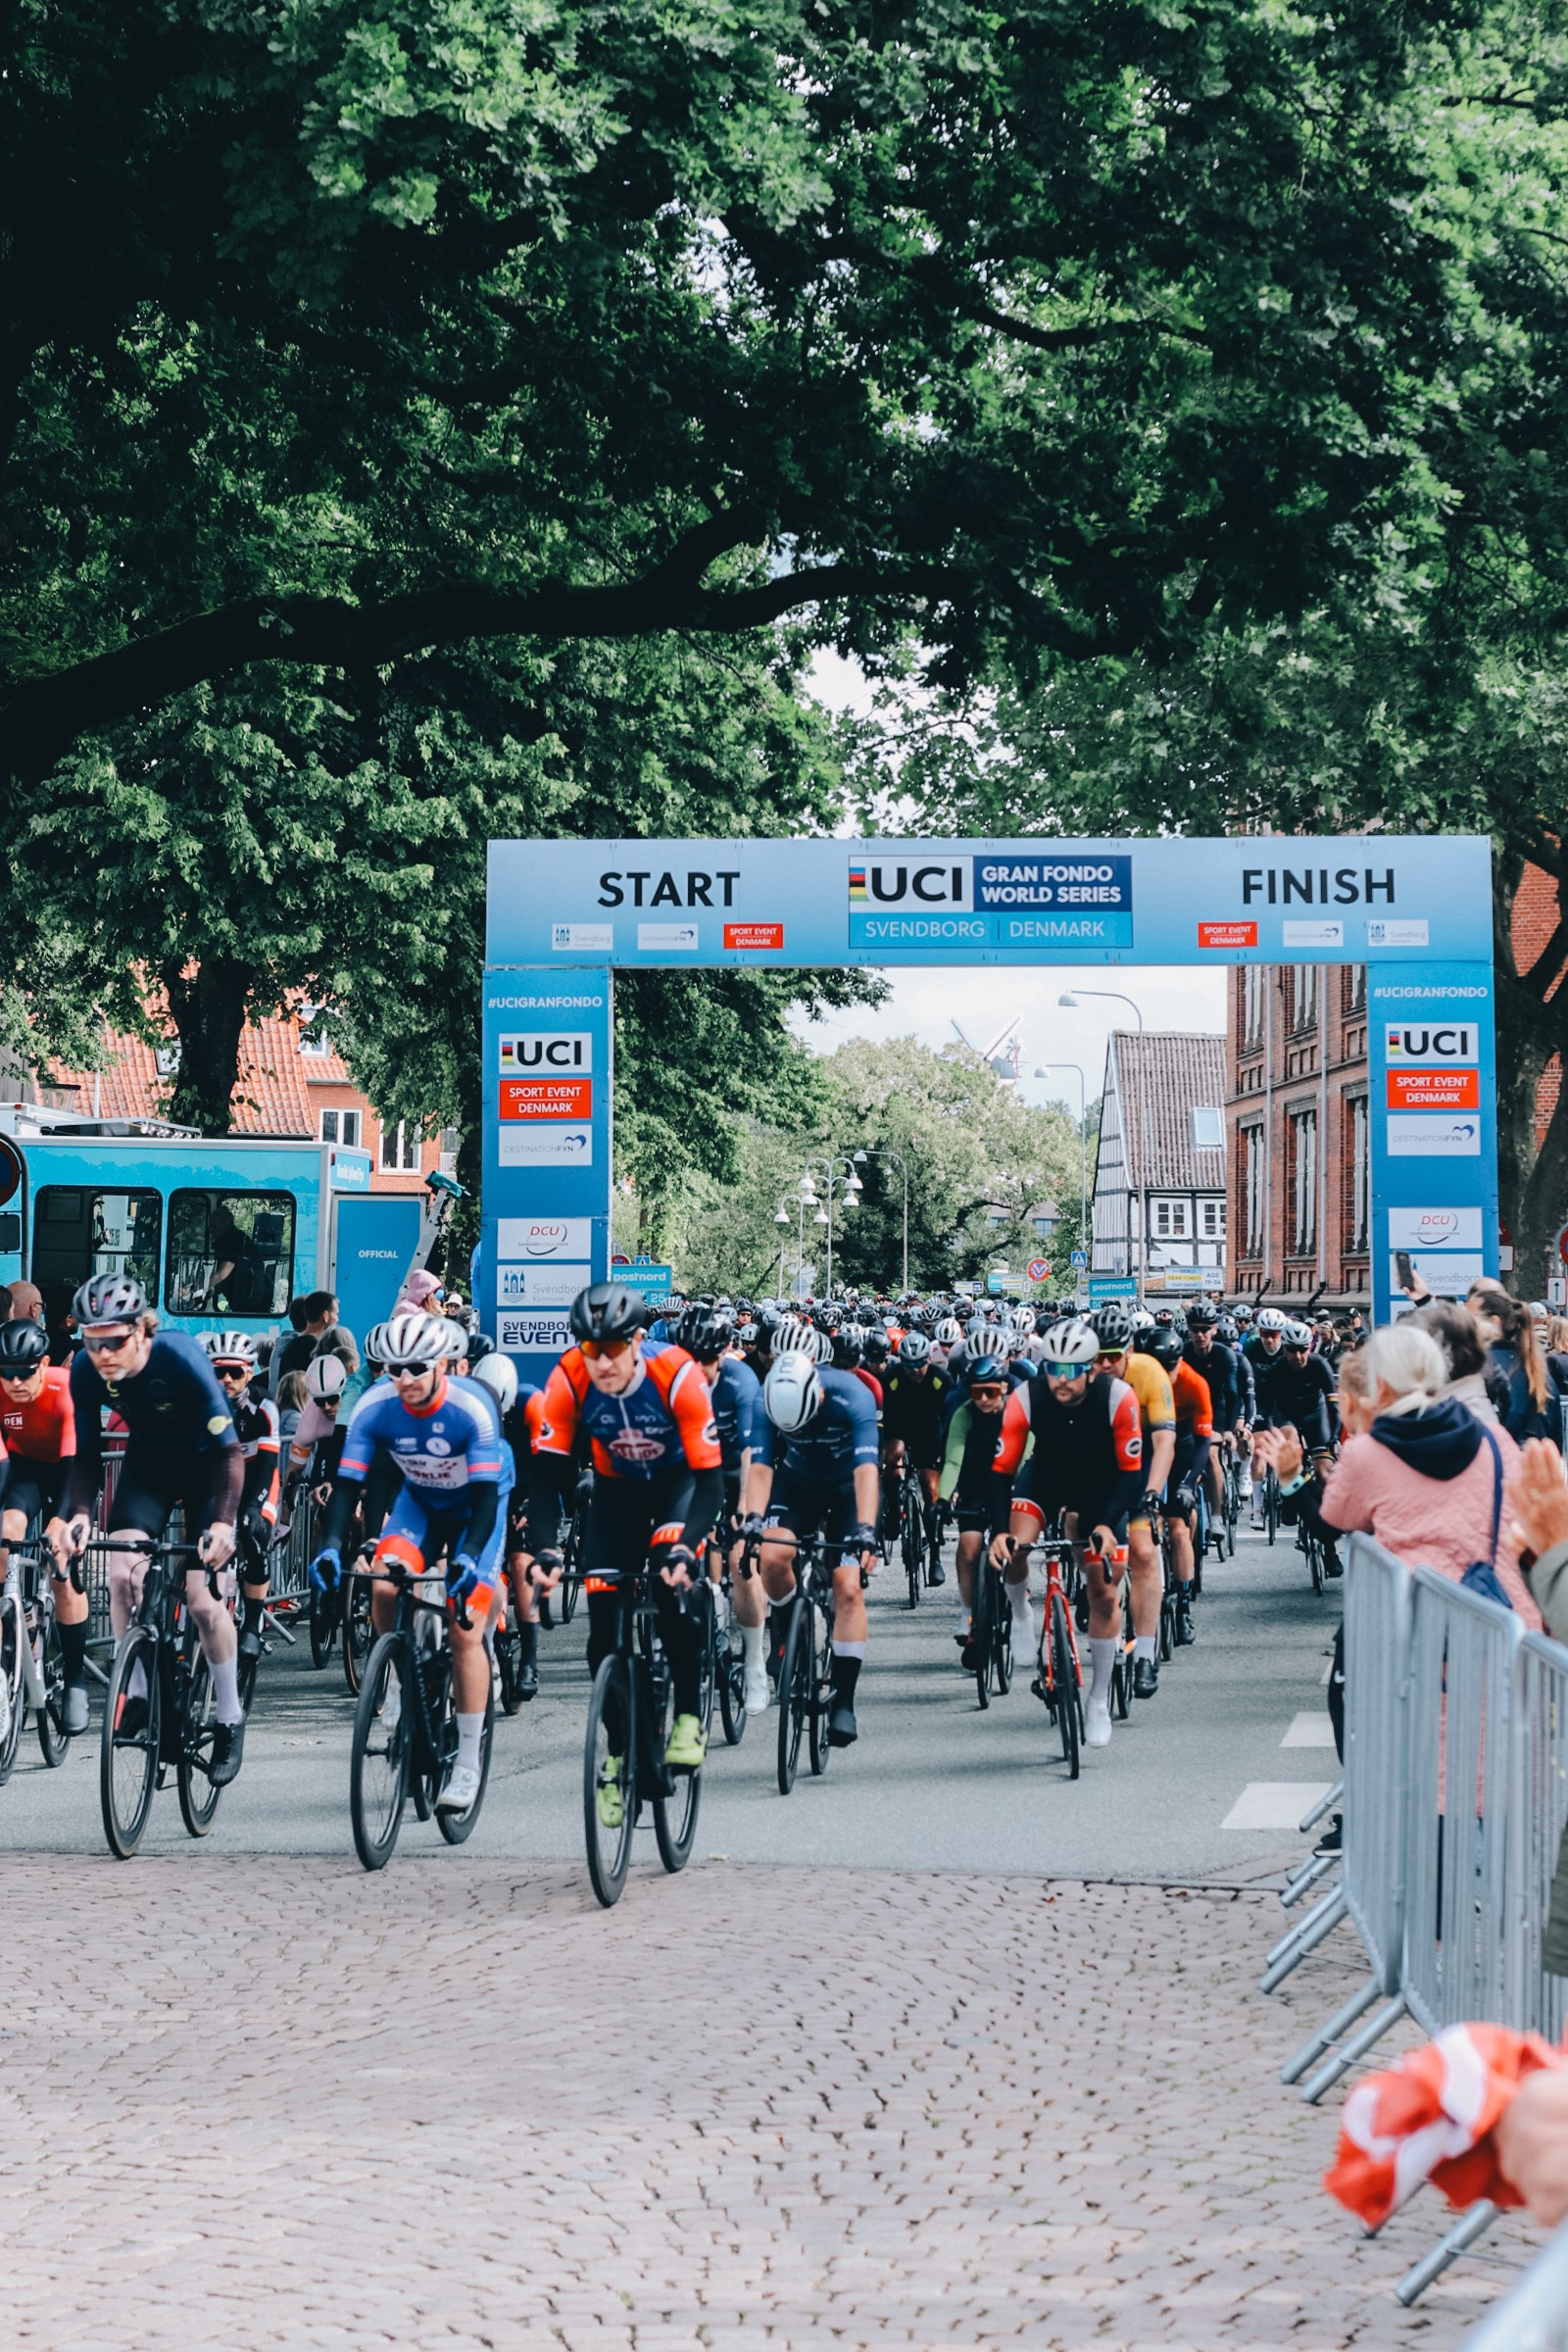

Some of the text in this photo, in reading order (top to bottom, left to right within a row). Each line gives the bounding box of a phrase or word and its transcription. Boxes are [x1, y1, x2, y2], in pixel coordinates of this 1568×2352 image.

[981, 864, 1113, 883] GRAN FONDO
[597, 871, 741, 907] START
[871, 866, 962, 903] UCI
[1243, 868, 1395, 904] FINISH
[981, 886, 1122, 904] WORLD SERIES
[729, 927, 777, 936] SPORT EVENT
[864, 920, 1104, 938] SVENDBORG DENMARK
[1203, 925, 1251, 935] SPORT EVENT
[735, 938, 771, 947] DENMARK
[1209, 936, 1247, 945] DENMARK
[1373, 986, 1488, 999] #UCIGRANFONDO
[488, 996, 603, 1008] #UCIGRANFONDO
[1403, 1030, 1468, 1055] UCI
[517, 1041, 582, 1066] UCI
[1396, 1076, 1469, 1087] SPORT EVENT
[509, 1086, 582, 1098] SPORT EVENT
[1405, 1093, 1460, 1102] DENMARK
[518, 1102, 573, 1113] DENMARK
[504, 1145, 573, 1153] DESTINATIONFYN
[1421, 1214, 1450, 1225] DCU
[530, 1226, 560, 1236] DCU
[358, 1250, 399, 1258] OFFICIAL
[612, 1272, 666, 1282] postnord
[1093, 1281, 1132, 1293] postnord
[503, 1332, 568, 1345] EVEN
